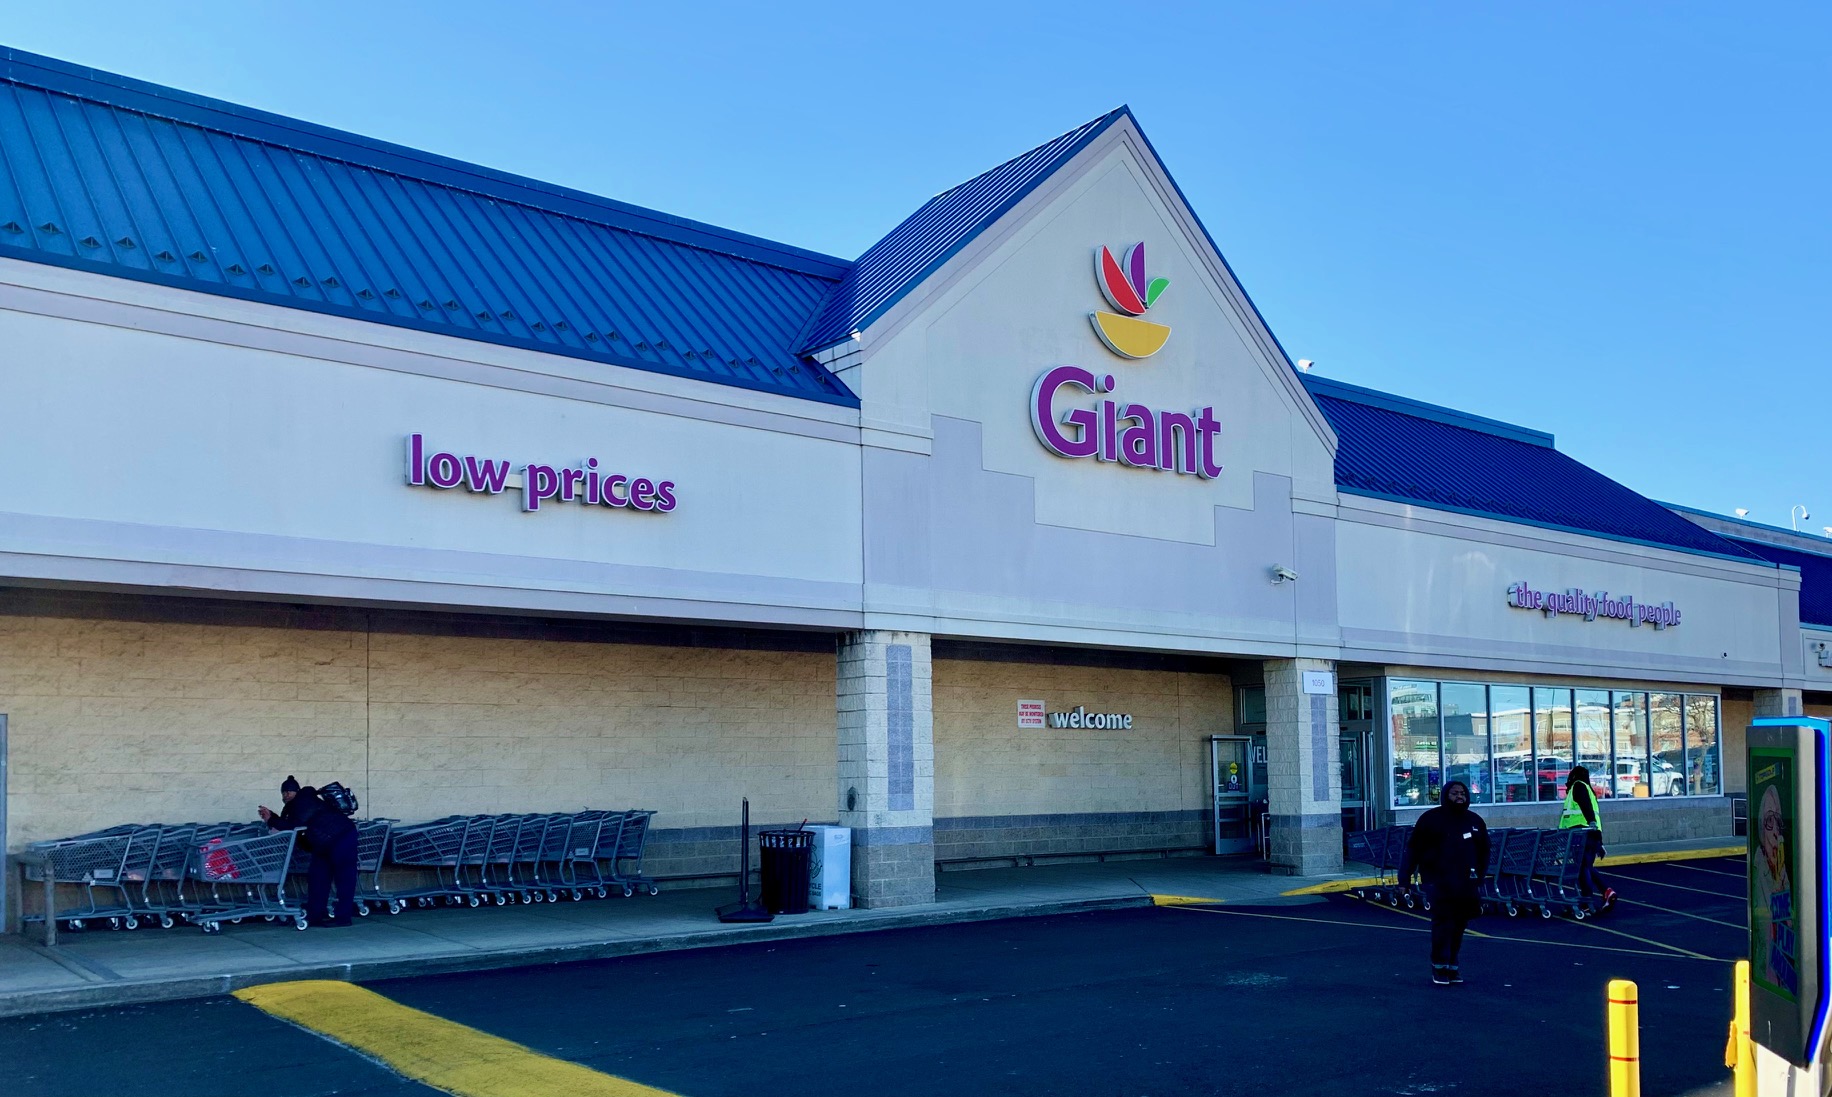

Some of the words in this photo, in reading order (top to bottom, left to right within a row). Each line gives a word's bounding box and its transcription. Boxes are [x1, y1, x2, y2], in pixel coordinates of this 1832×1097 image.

[1033, 365, 1224, 478] Giant
[409, 433, 511, 494] low
[524, 457, 677, 513] prices
[1513, 581, 1543, 609] the
[1547, 588, 1599, 621] quality
[1600, 591, 1634, 619] food
[1638, 602, 1682, 627] people
[1052, 705, 1133, 730] welcome
